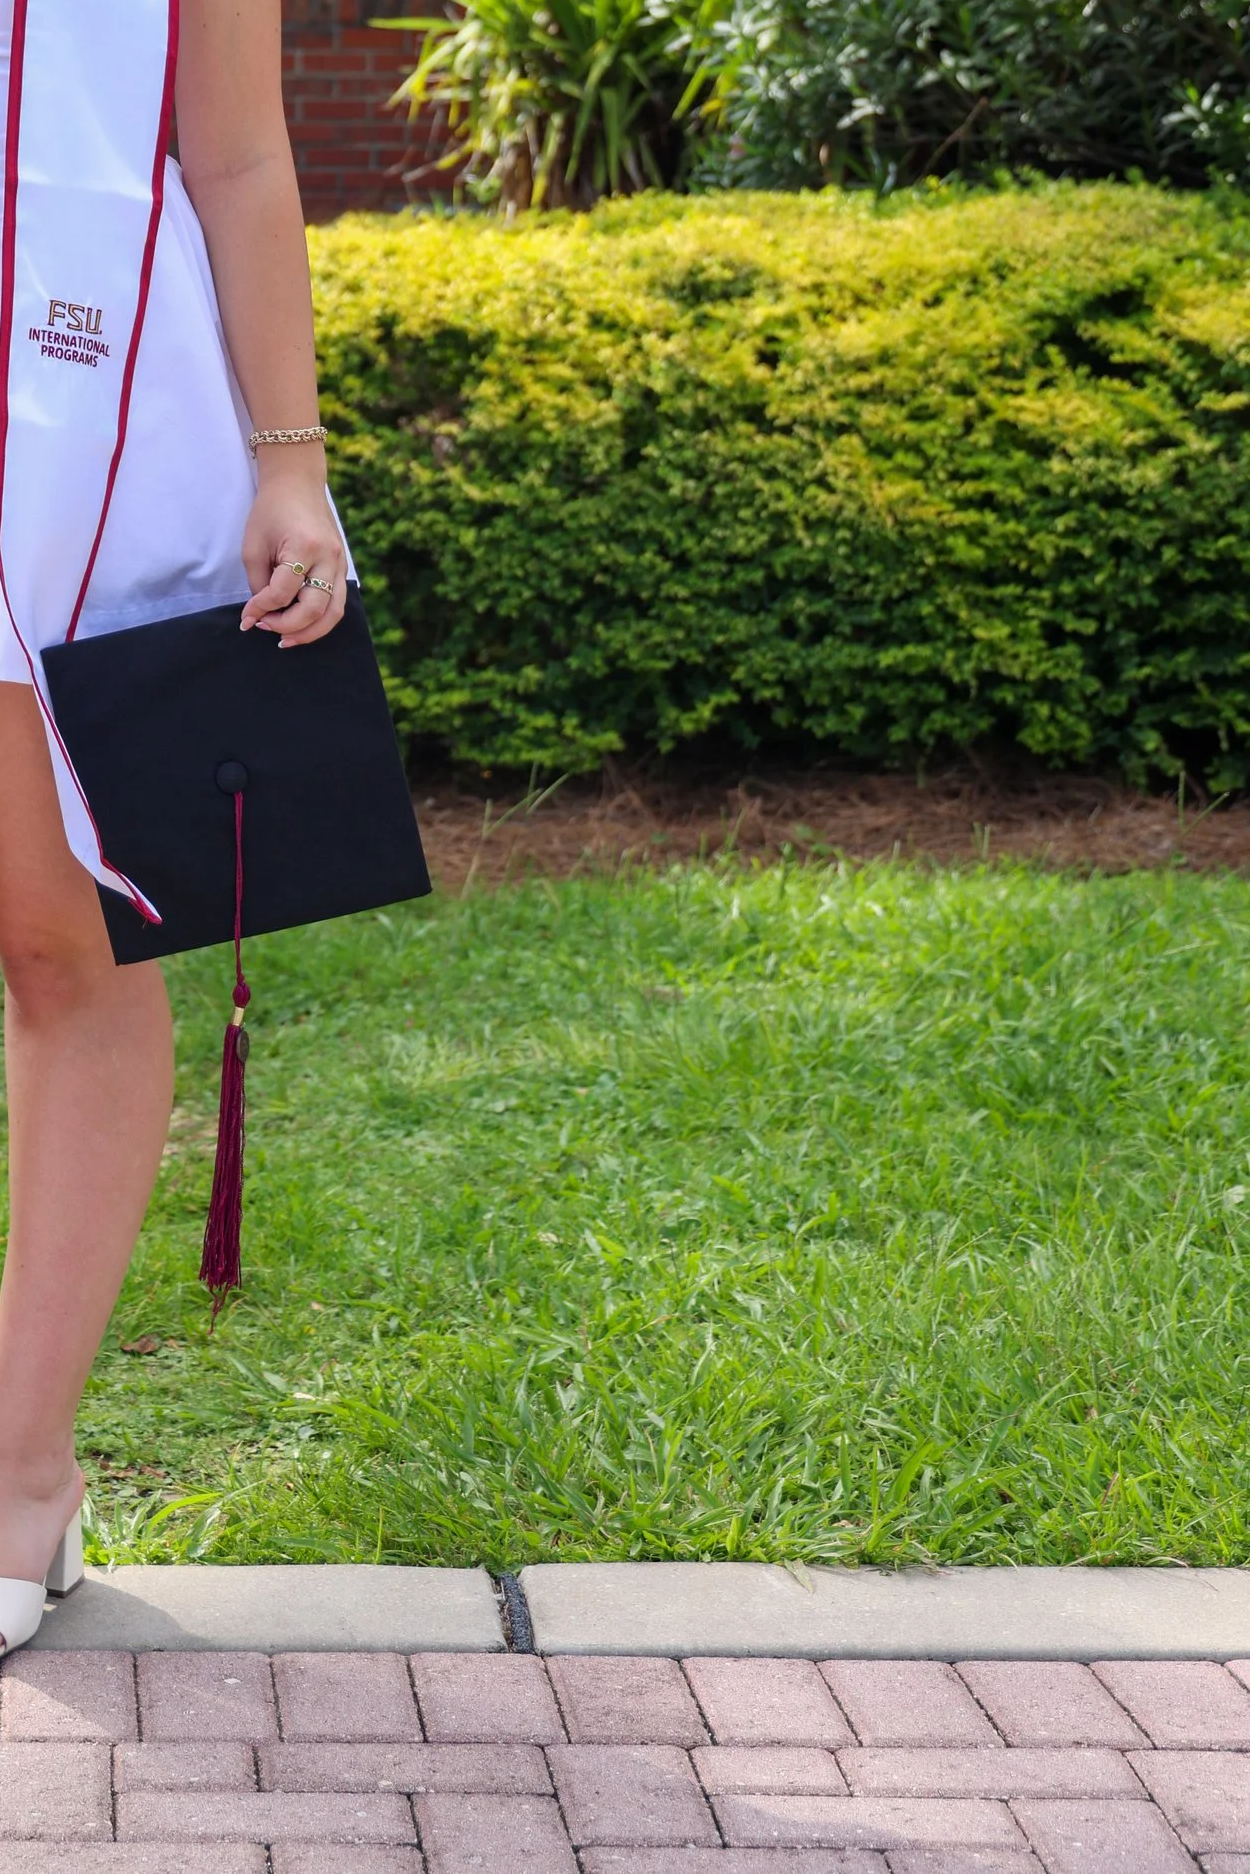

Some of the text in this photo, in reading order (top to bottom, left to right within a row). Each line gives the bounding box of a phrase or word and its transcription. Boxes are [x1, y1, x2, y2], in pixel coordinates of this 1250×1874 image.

[48, 299, 102, 335] FSU
[29, 327, 110, 357] INTERNATIONAL
[41, 344, 98, 367] PROGRAMS
